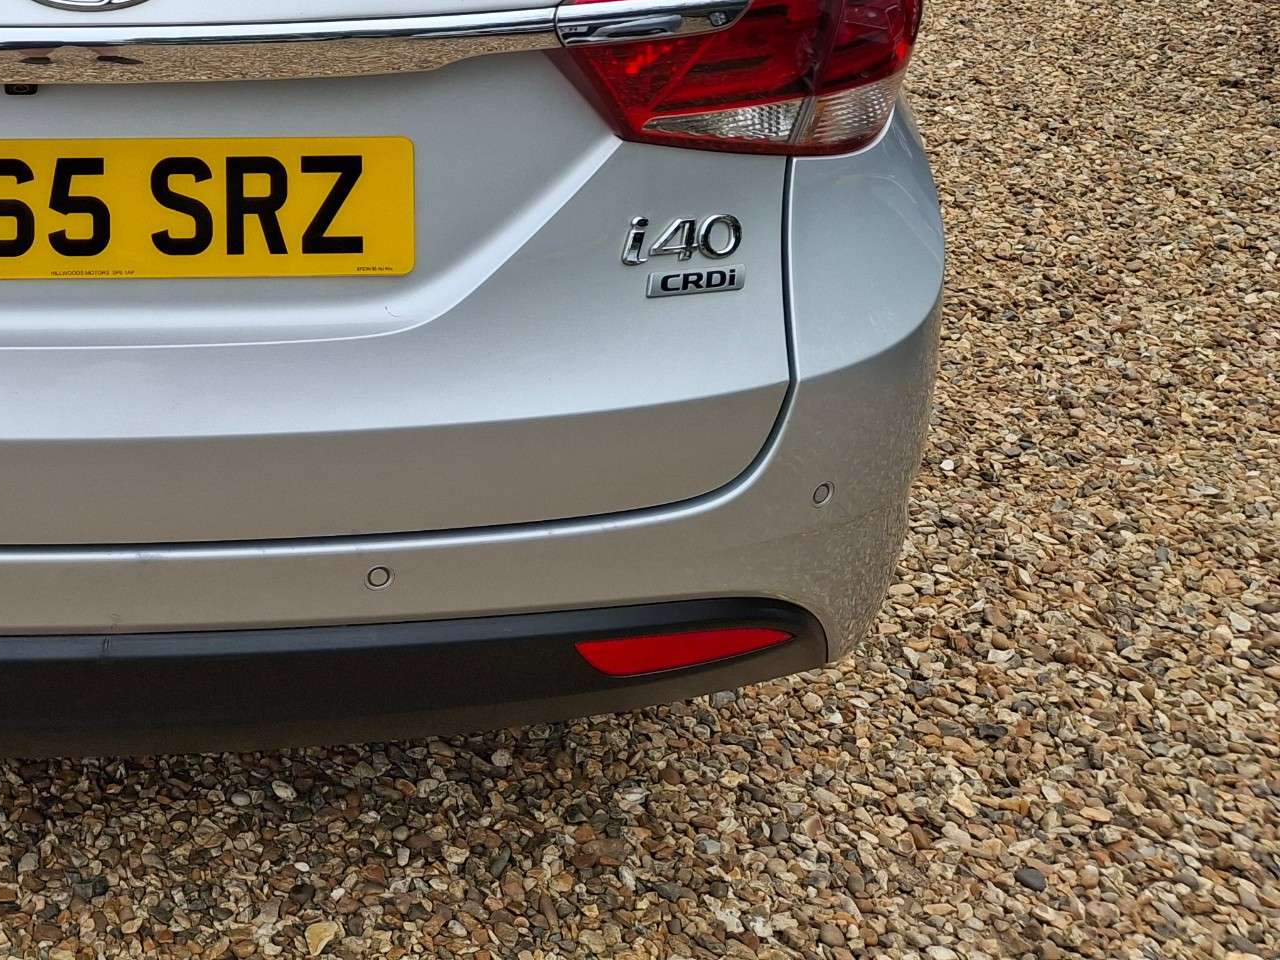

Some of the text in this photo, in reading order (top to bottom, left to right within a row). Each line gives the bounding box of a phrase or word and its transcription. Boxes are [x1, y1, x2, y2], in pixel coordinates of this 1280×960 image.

[150, 155, 364, 256] SRZ
[621, 213, 742, 266] i40
[660, 268, 737, 292] CRDi
